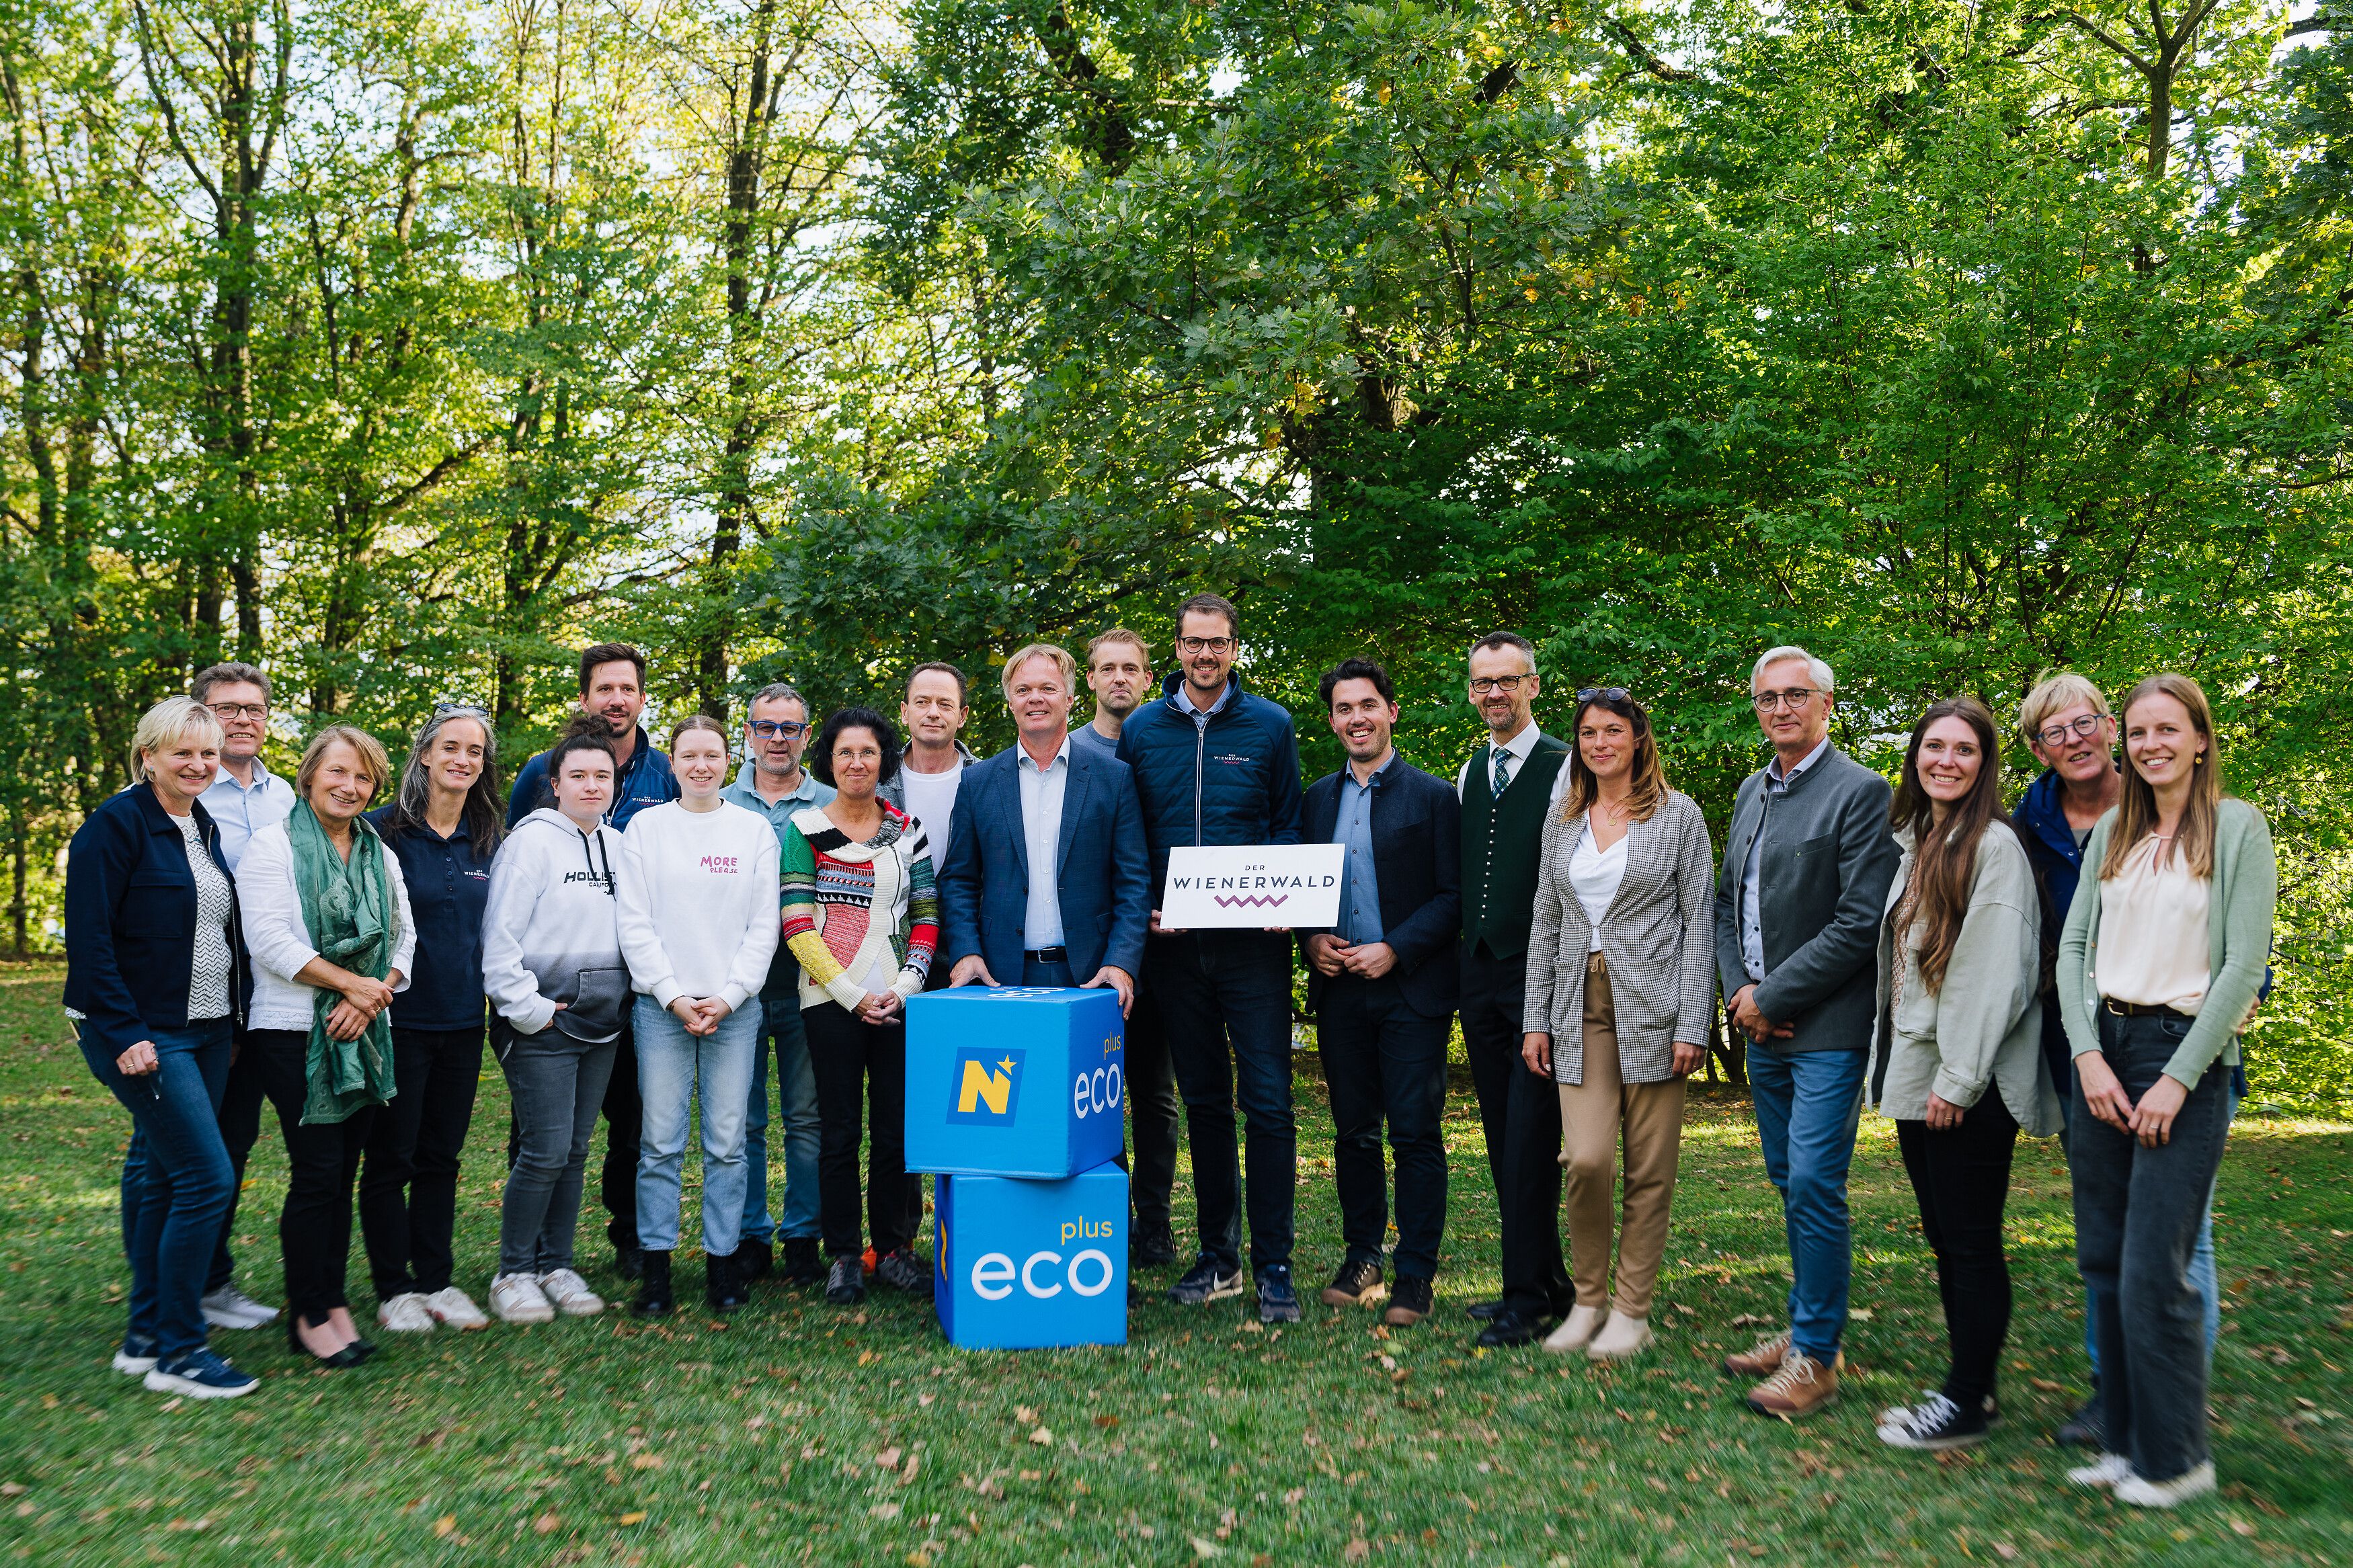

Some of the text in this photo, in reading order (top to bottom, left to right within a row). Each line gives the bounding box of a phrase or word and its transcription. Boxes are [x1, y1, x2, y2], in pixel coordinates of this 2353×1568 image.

[701, 856, 737, 867] MORE
[1174, 875, 1334, 889] WIENERWALD
[1104, 1031, 1121, 1060] plus
[1074, 1063, 1121, 1119] eco
[1062, 1215, 1113, 1245] plus
[971, 1249, 1113, 1301] eco
